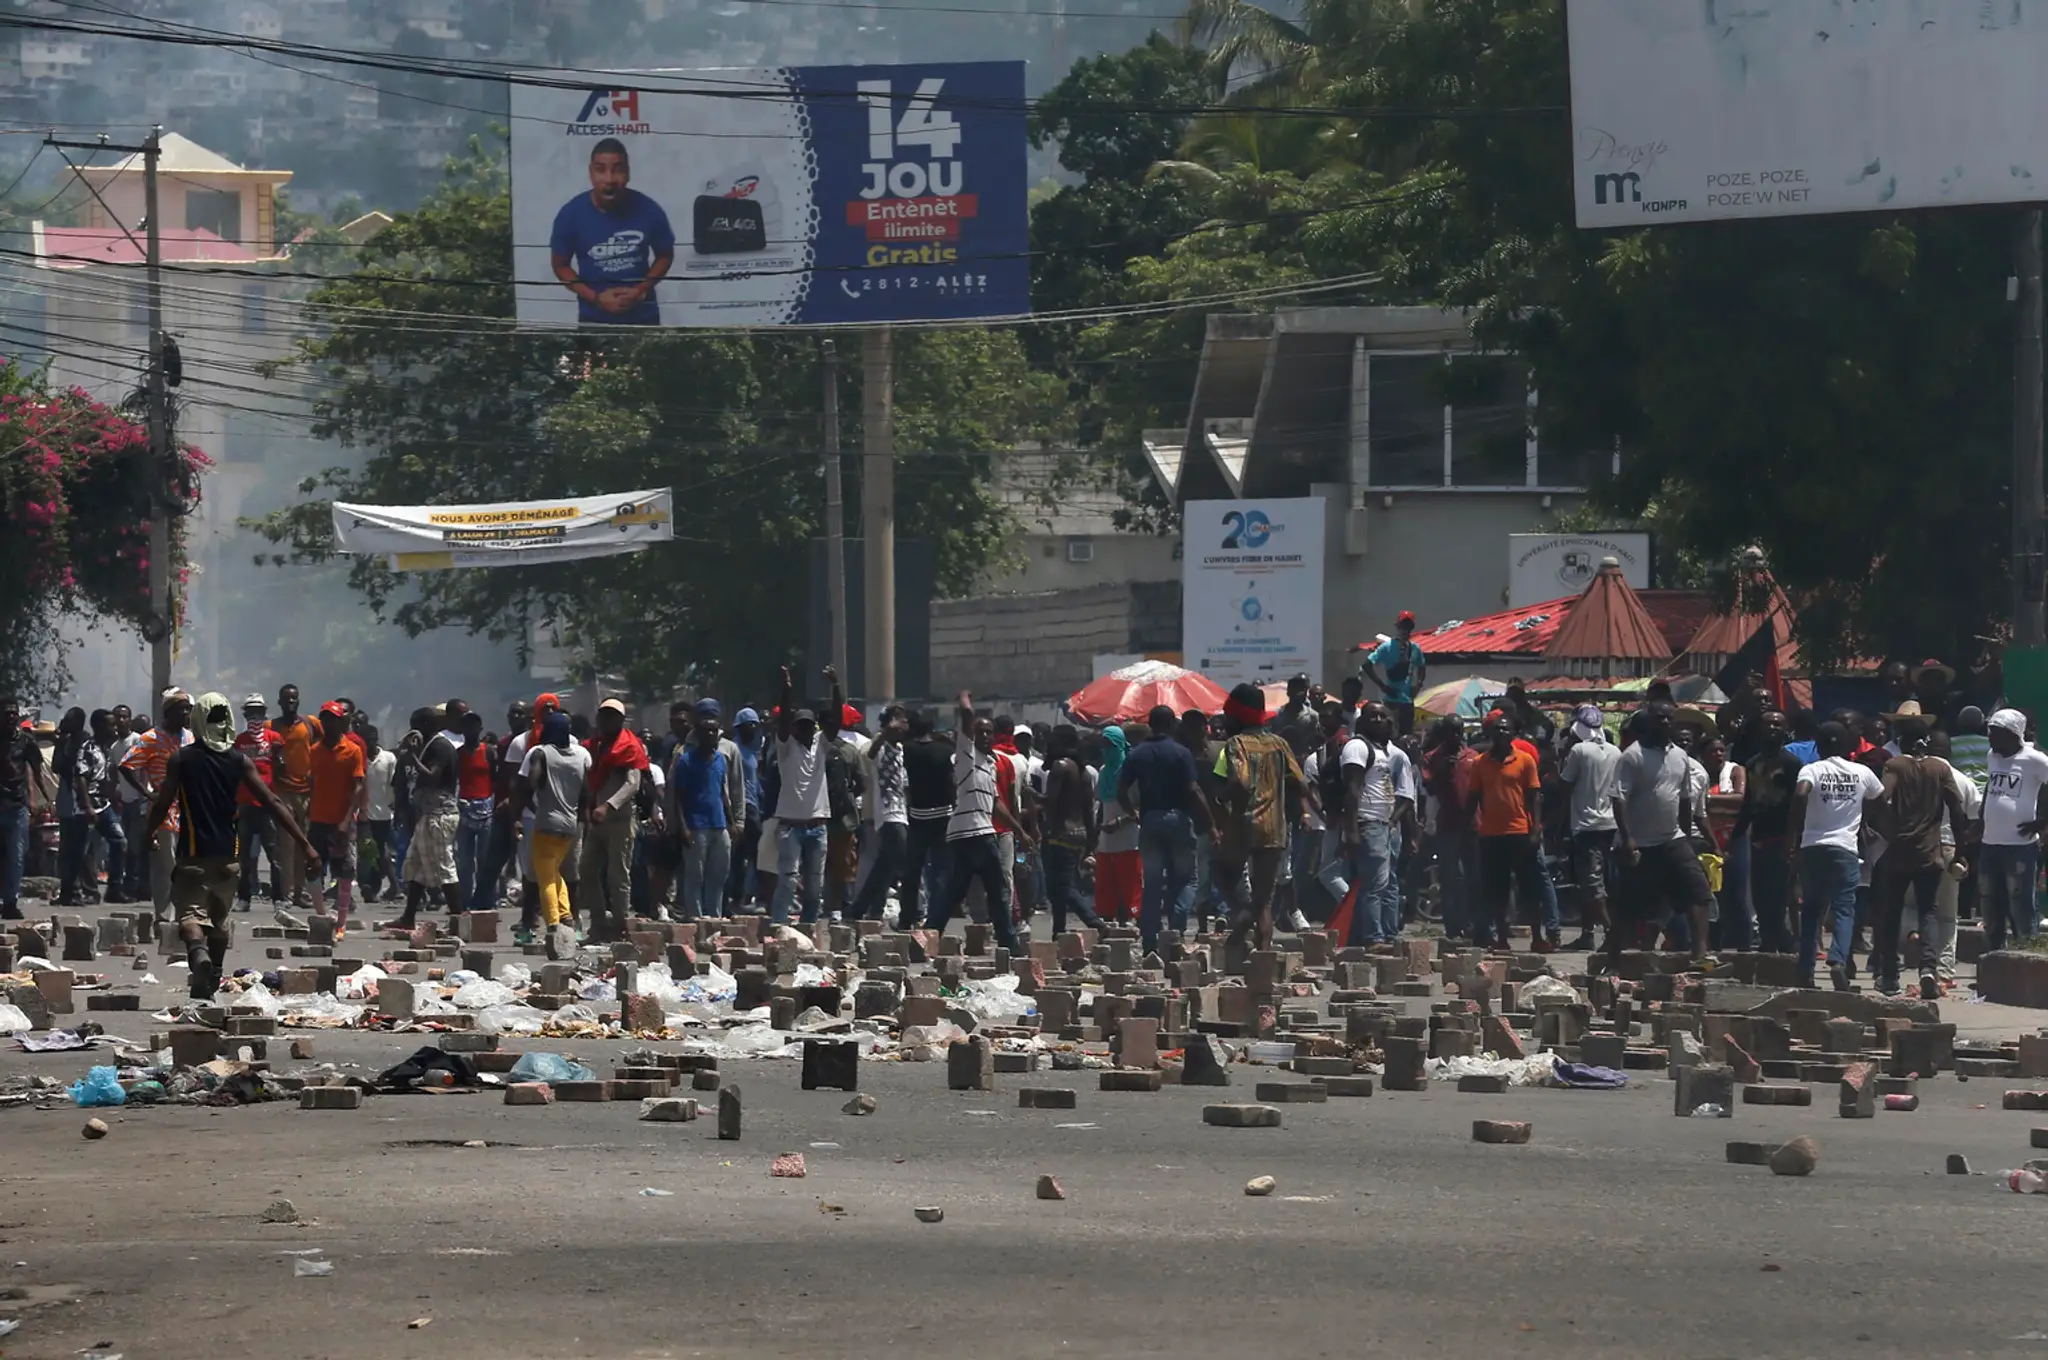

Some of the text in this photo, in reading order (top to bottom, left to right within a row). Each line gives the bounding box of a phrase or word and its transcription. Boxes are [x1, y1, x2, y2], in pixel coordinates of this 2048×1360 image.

[856, 77, 962, 159] 14
[859, 161, 963, 199] JOU
[1706, 170, 1810, 188] POZE, POZE,
[1778, 188, 1811, 203] NET
[867, 199, 958, 221] Entènèt
[1642, 200, 1688, 212] KONPA
[884, 222, 947, 238] ilimite
[866, 242, 958, 267] Gratis
[431, 507, 575, 523] NOUS AVONS DÉMÉNAGÉ
[1221, 509, 1271, 549] 20
[1989, 773, 2020, 790] MTV
